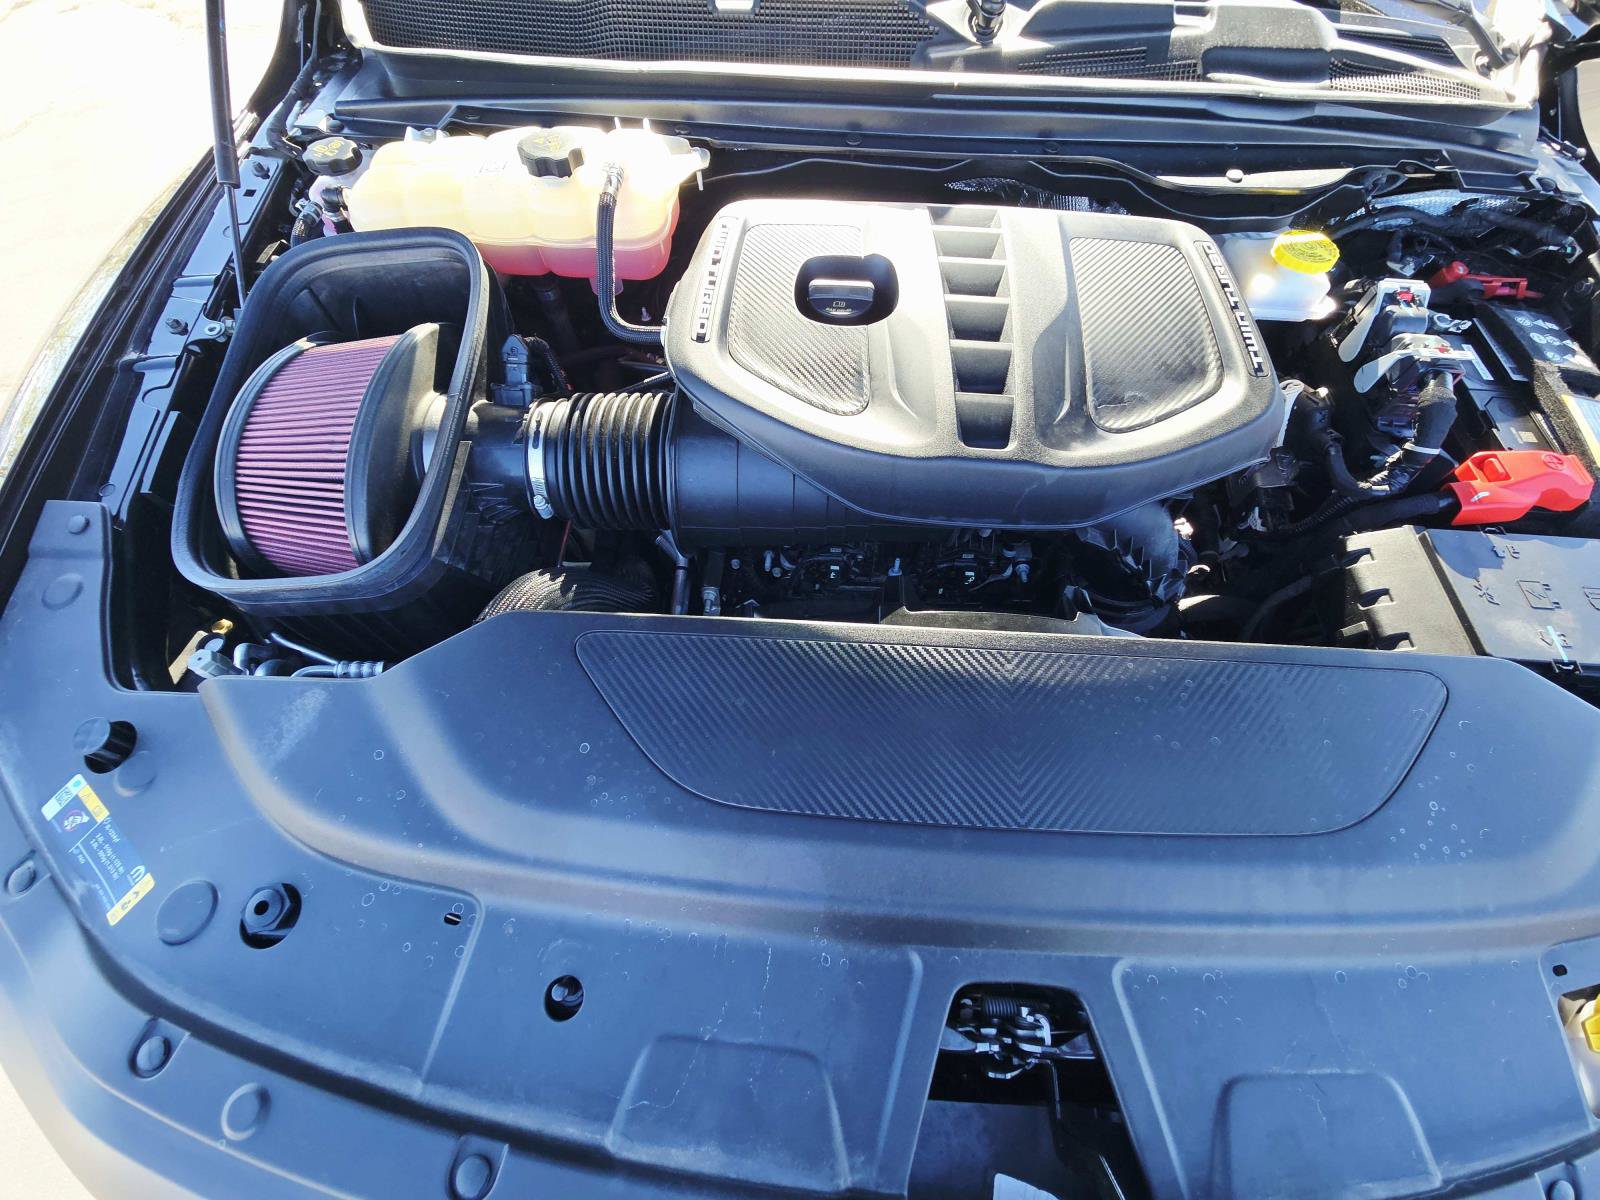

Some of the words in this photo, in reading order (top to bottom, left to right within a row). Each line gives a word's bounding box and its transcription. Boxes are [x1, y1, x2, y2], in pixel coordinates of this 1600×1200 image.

[697, 261, 720, 334] TURBO
[1203, 243, 1239, 307] TURBO
[1236, 311, 1263, 370] TWIN
